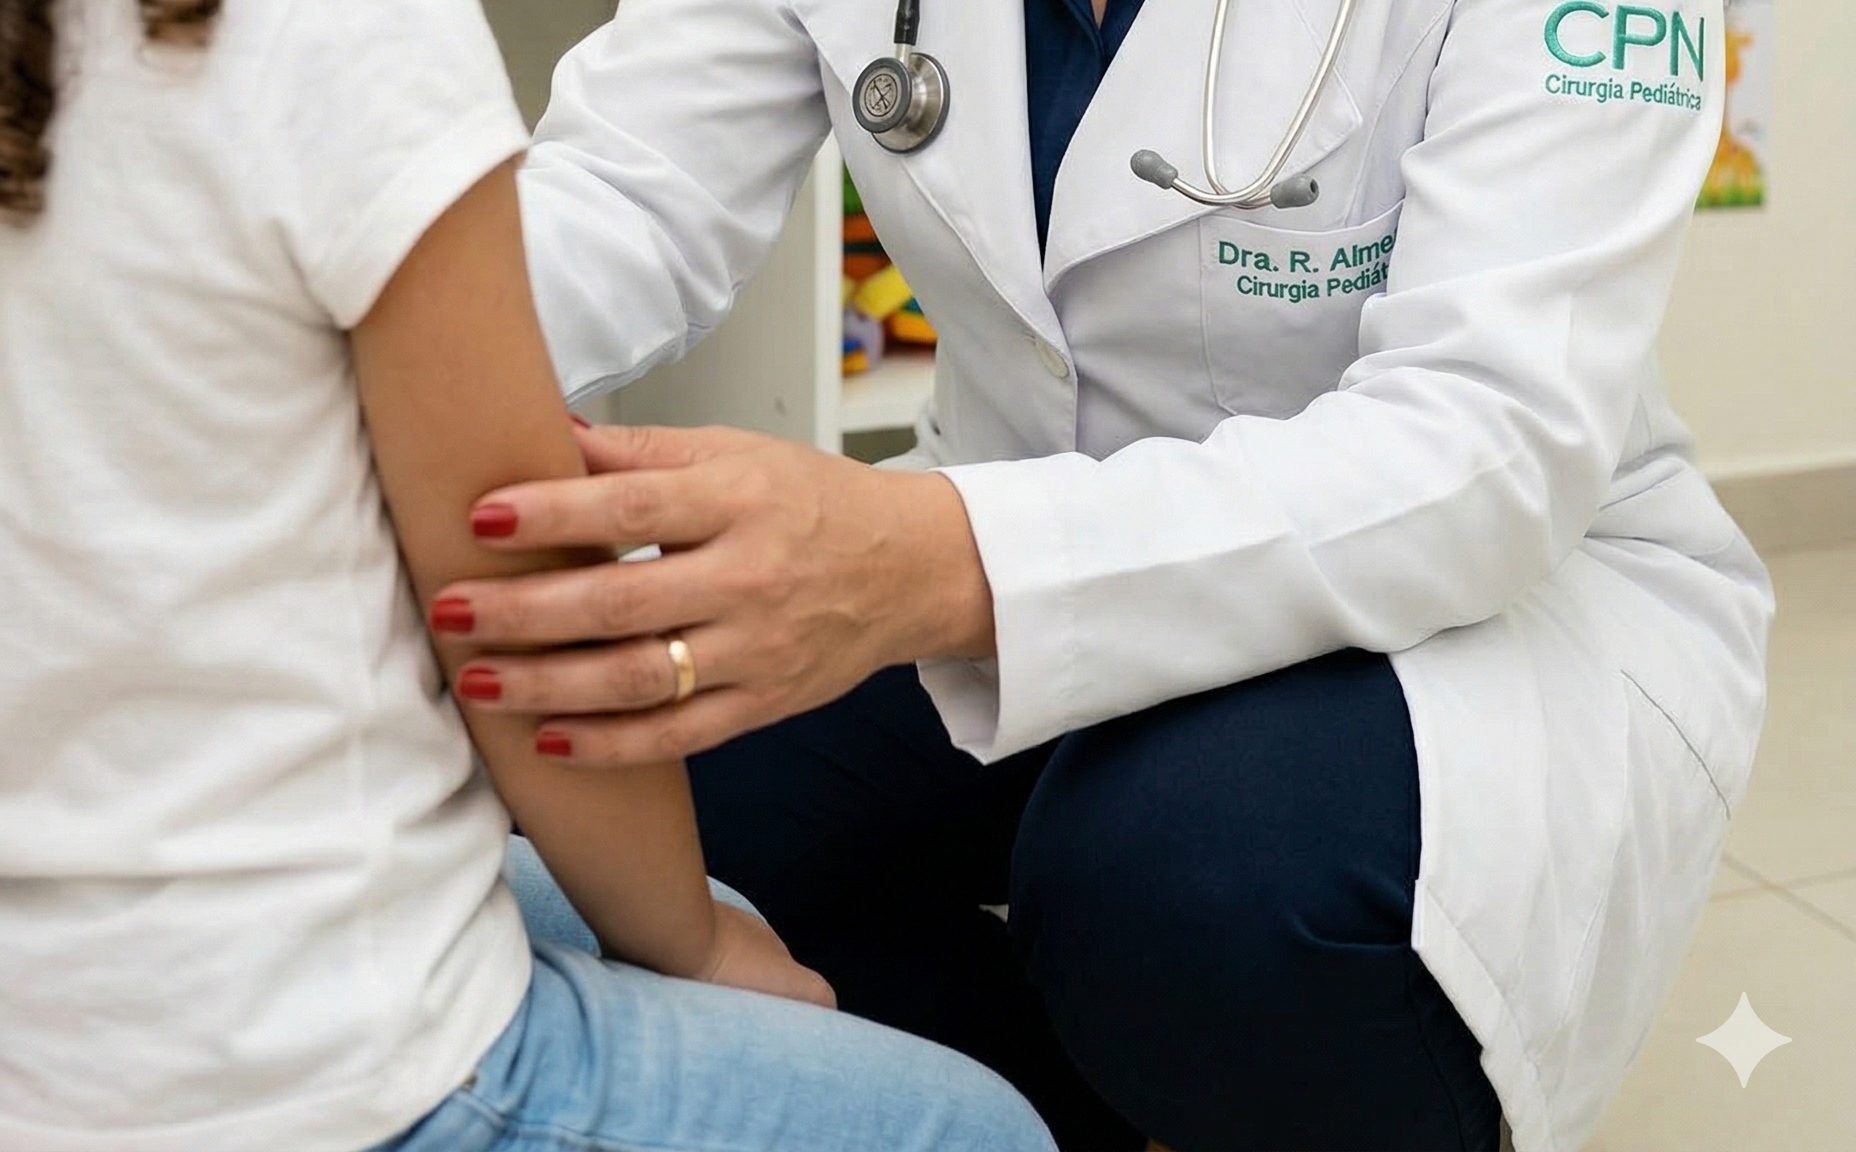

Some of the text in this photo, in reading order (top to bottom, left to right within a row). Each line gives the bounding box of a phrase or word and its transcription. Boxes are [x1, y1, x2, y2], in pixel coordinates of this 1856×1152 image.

[1544, 0, 1704, 83] CPN
[1545, 75, 1701, 110] Cirurgia Pediátrica
[1218, 240, 1279, 272] Dra.
[1289, 250, 1319, 273] R.
[1236, 275, 1320, 303] Cirurgia
